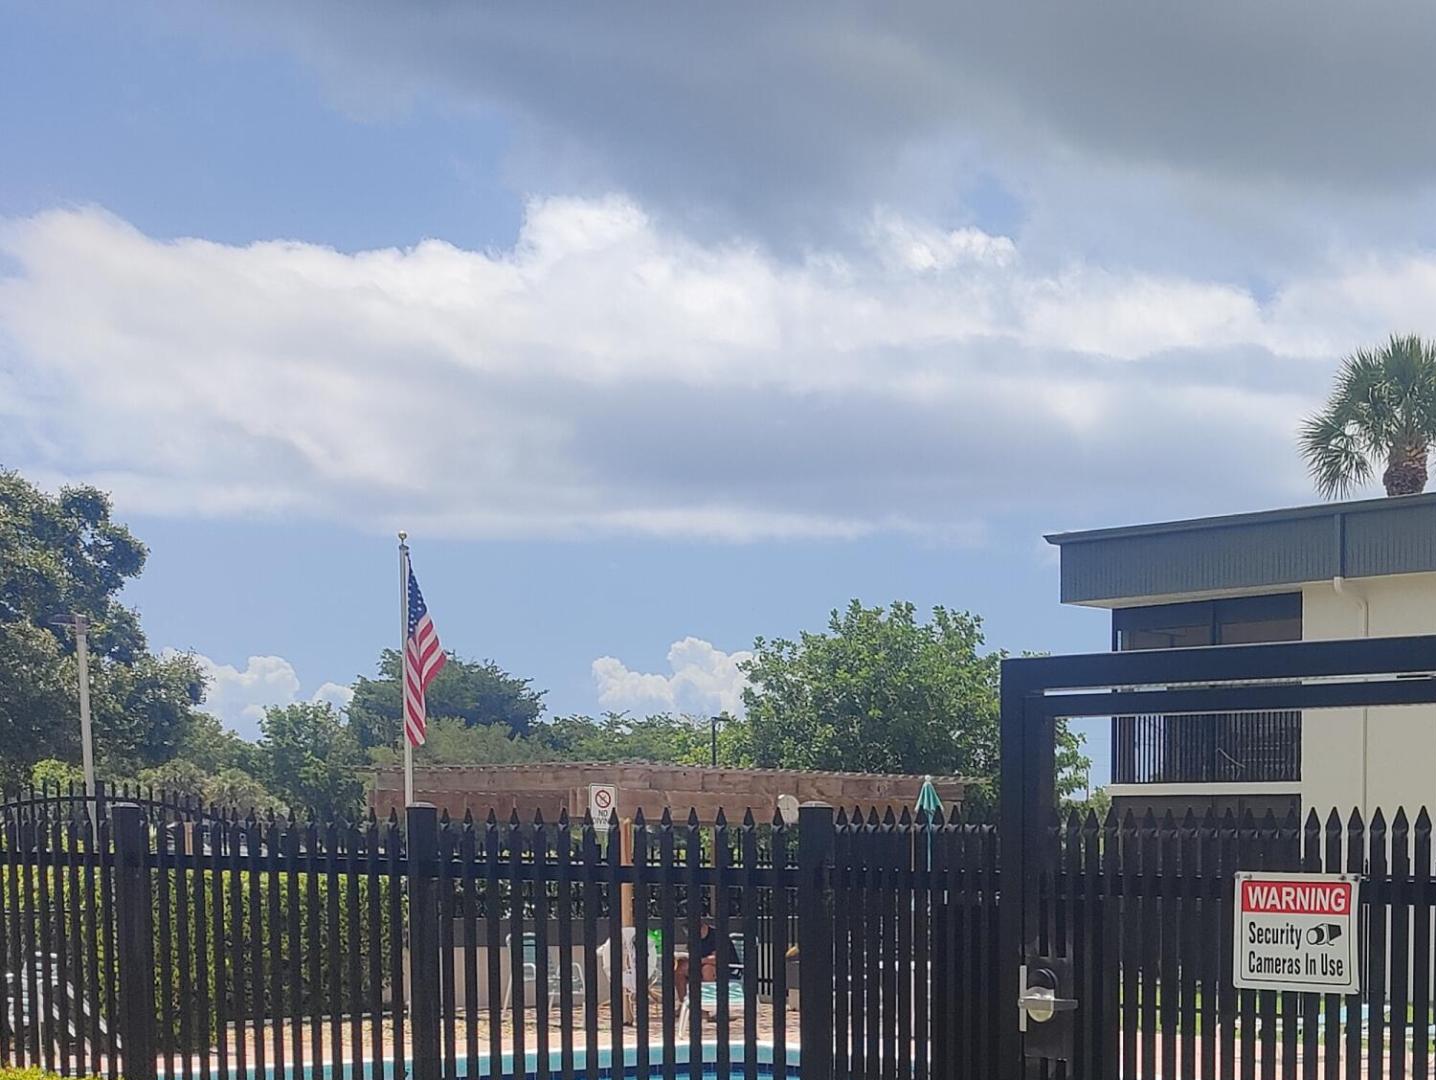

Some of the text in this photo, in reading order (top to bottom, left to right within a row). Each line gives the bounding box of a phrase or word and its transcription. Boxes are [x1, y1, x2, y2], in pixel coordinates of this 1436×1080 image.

[1248, 886, 1346, 912] WARNING
[1249, 921, 1302, 950] Security
[1249, 951, 1344, 976] Cameras In Use
